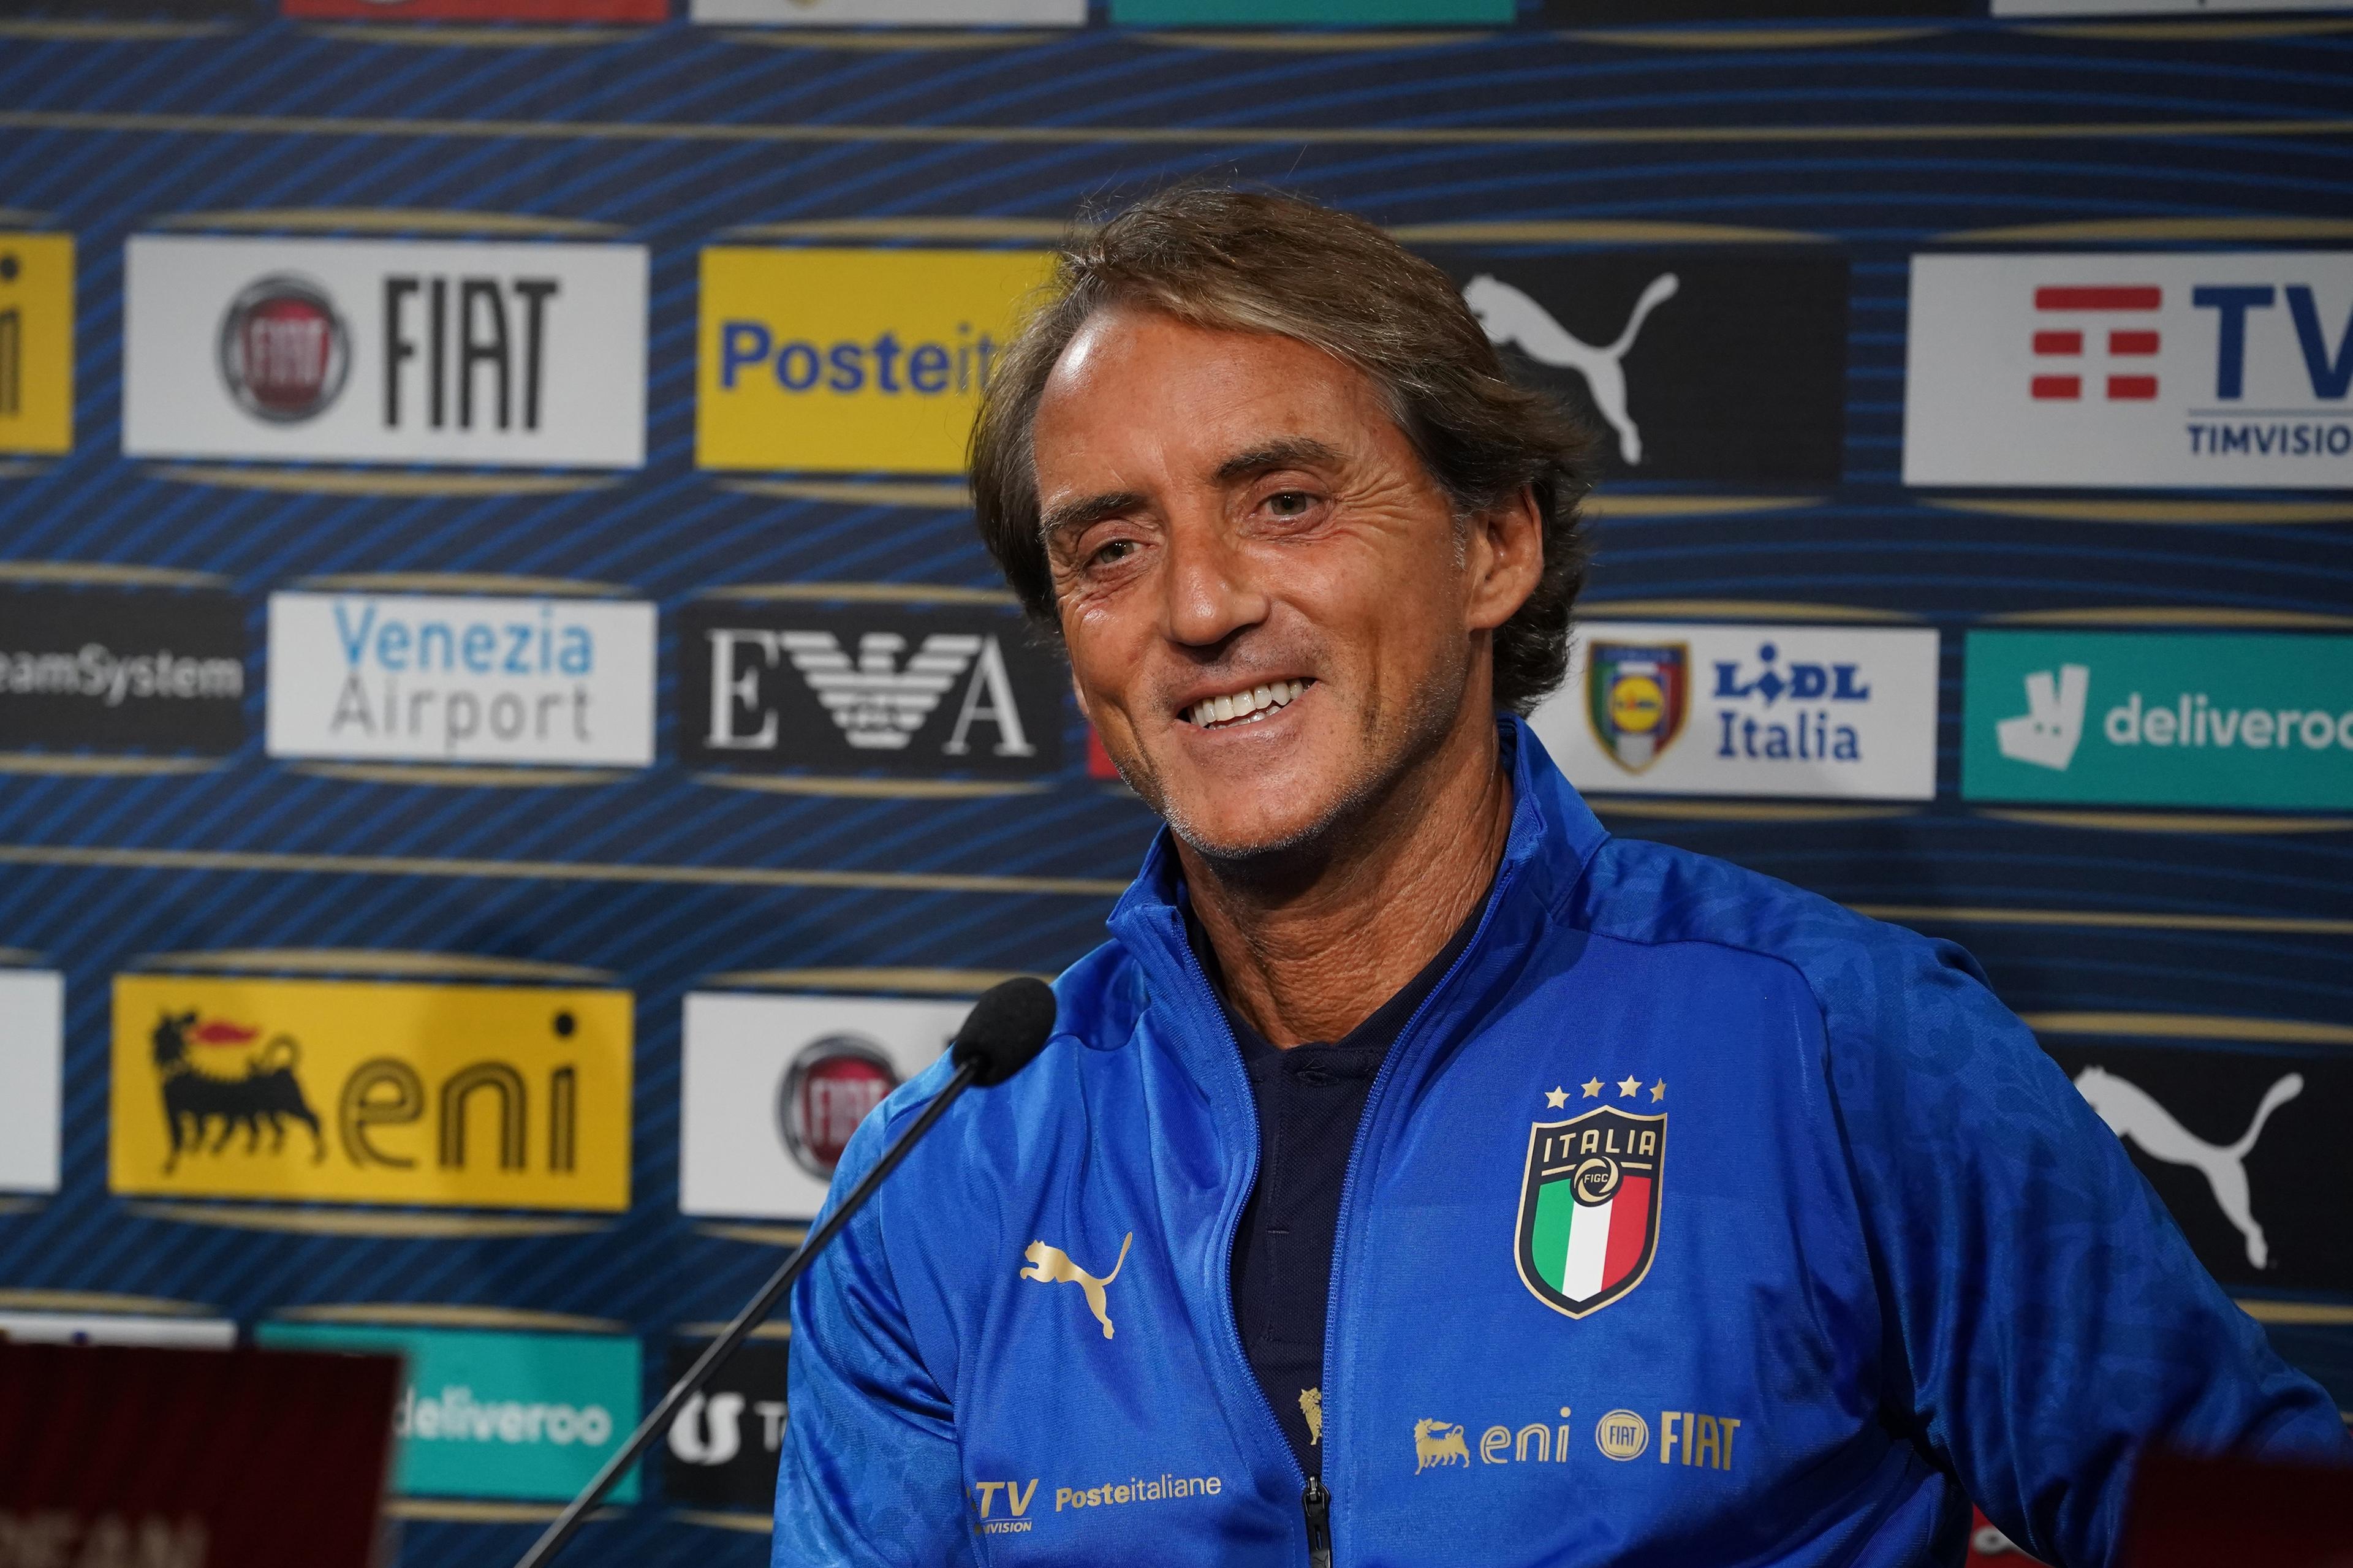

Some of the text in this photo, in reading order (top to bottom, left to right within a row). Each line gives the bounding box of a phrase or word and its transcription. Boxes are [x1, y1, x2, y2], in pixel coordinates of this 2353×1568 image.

[383, 276, 559, 431] FIAT
[2191, 284, 2353, 401] TV
[2186, 424, 2353, 456] TIMVISIO
[330, 600, 593, 675] Venezia
[328, 672, 591, 759] Airport
[1718, 711, 1860, 760] Italia
[339, 1011, 577, 1173] eni
[1544, 1129, 1656, 1162] ITALIA
[1583, 1173, 1609, 1183] FIGC
[1480, 1406, 1741, 1471] eni FIAT FIAT
[976, 1478, 1039, 1518] TV
[1056, 1474, 1221, 1512] Posteitaliane
